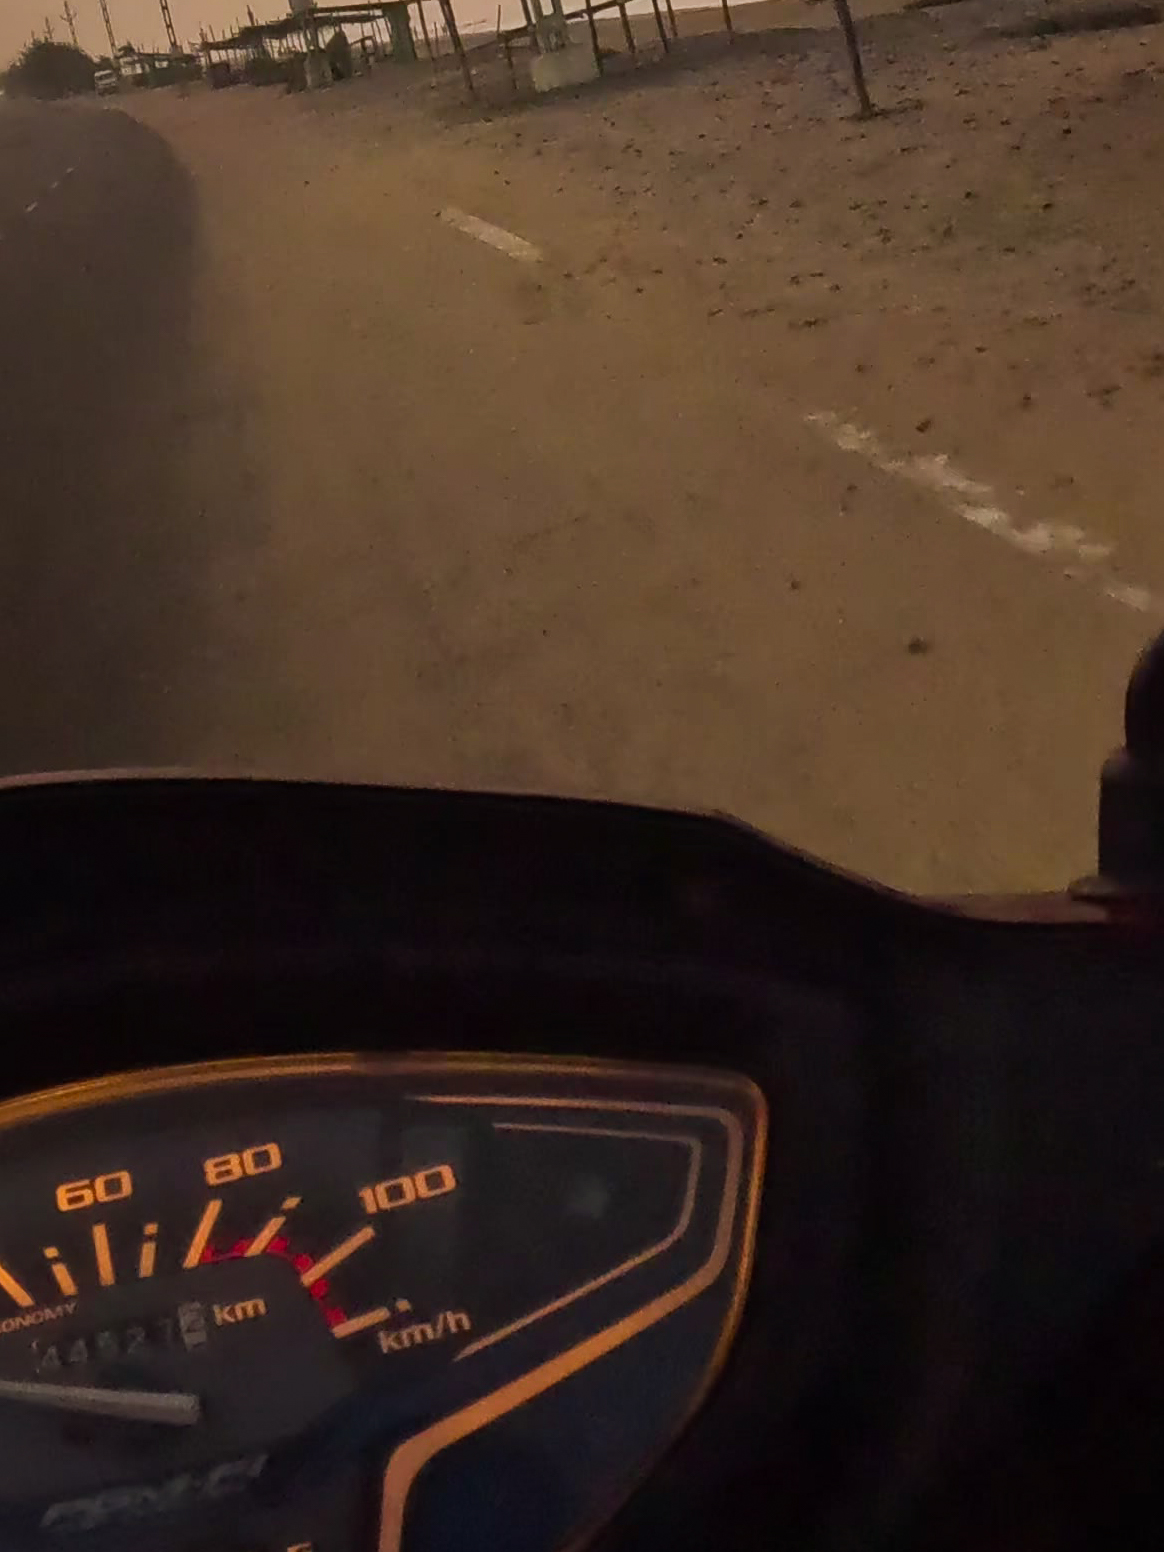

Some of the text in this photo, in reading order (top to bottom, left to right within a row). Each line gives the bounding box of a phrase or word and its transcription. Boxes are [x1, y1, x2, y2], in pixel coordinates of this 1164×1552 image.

[204, 1143, 281, 1186] 80
[57, 1171, 132, 1212] 60
[359, 1164, 456, 1213] 100
[0, 1302, 77, 1333] ONOMY
[213, 1298, 267, 1325] km
[379, 1310, 471, 1353] km/h
